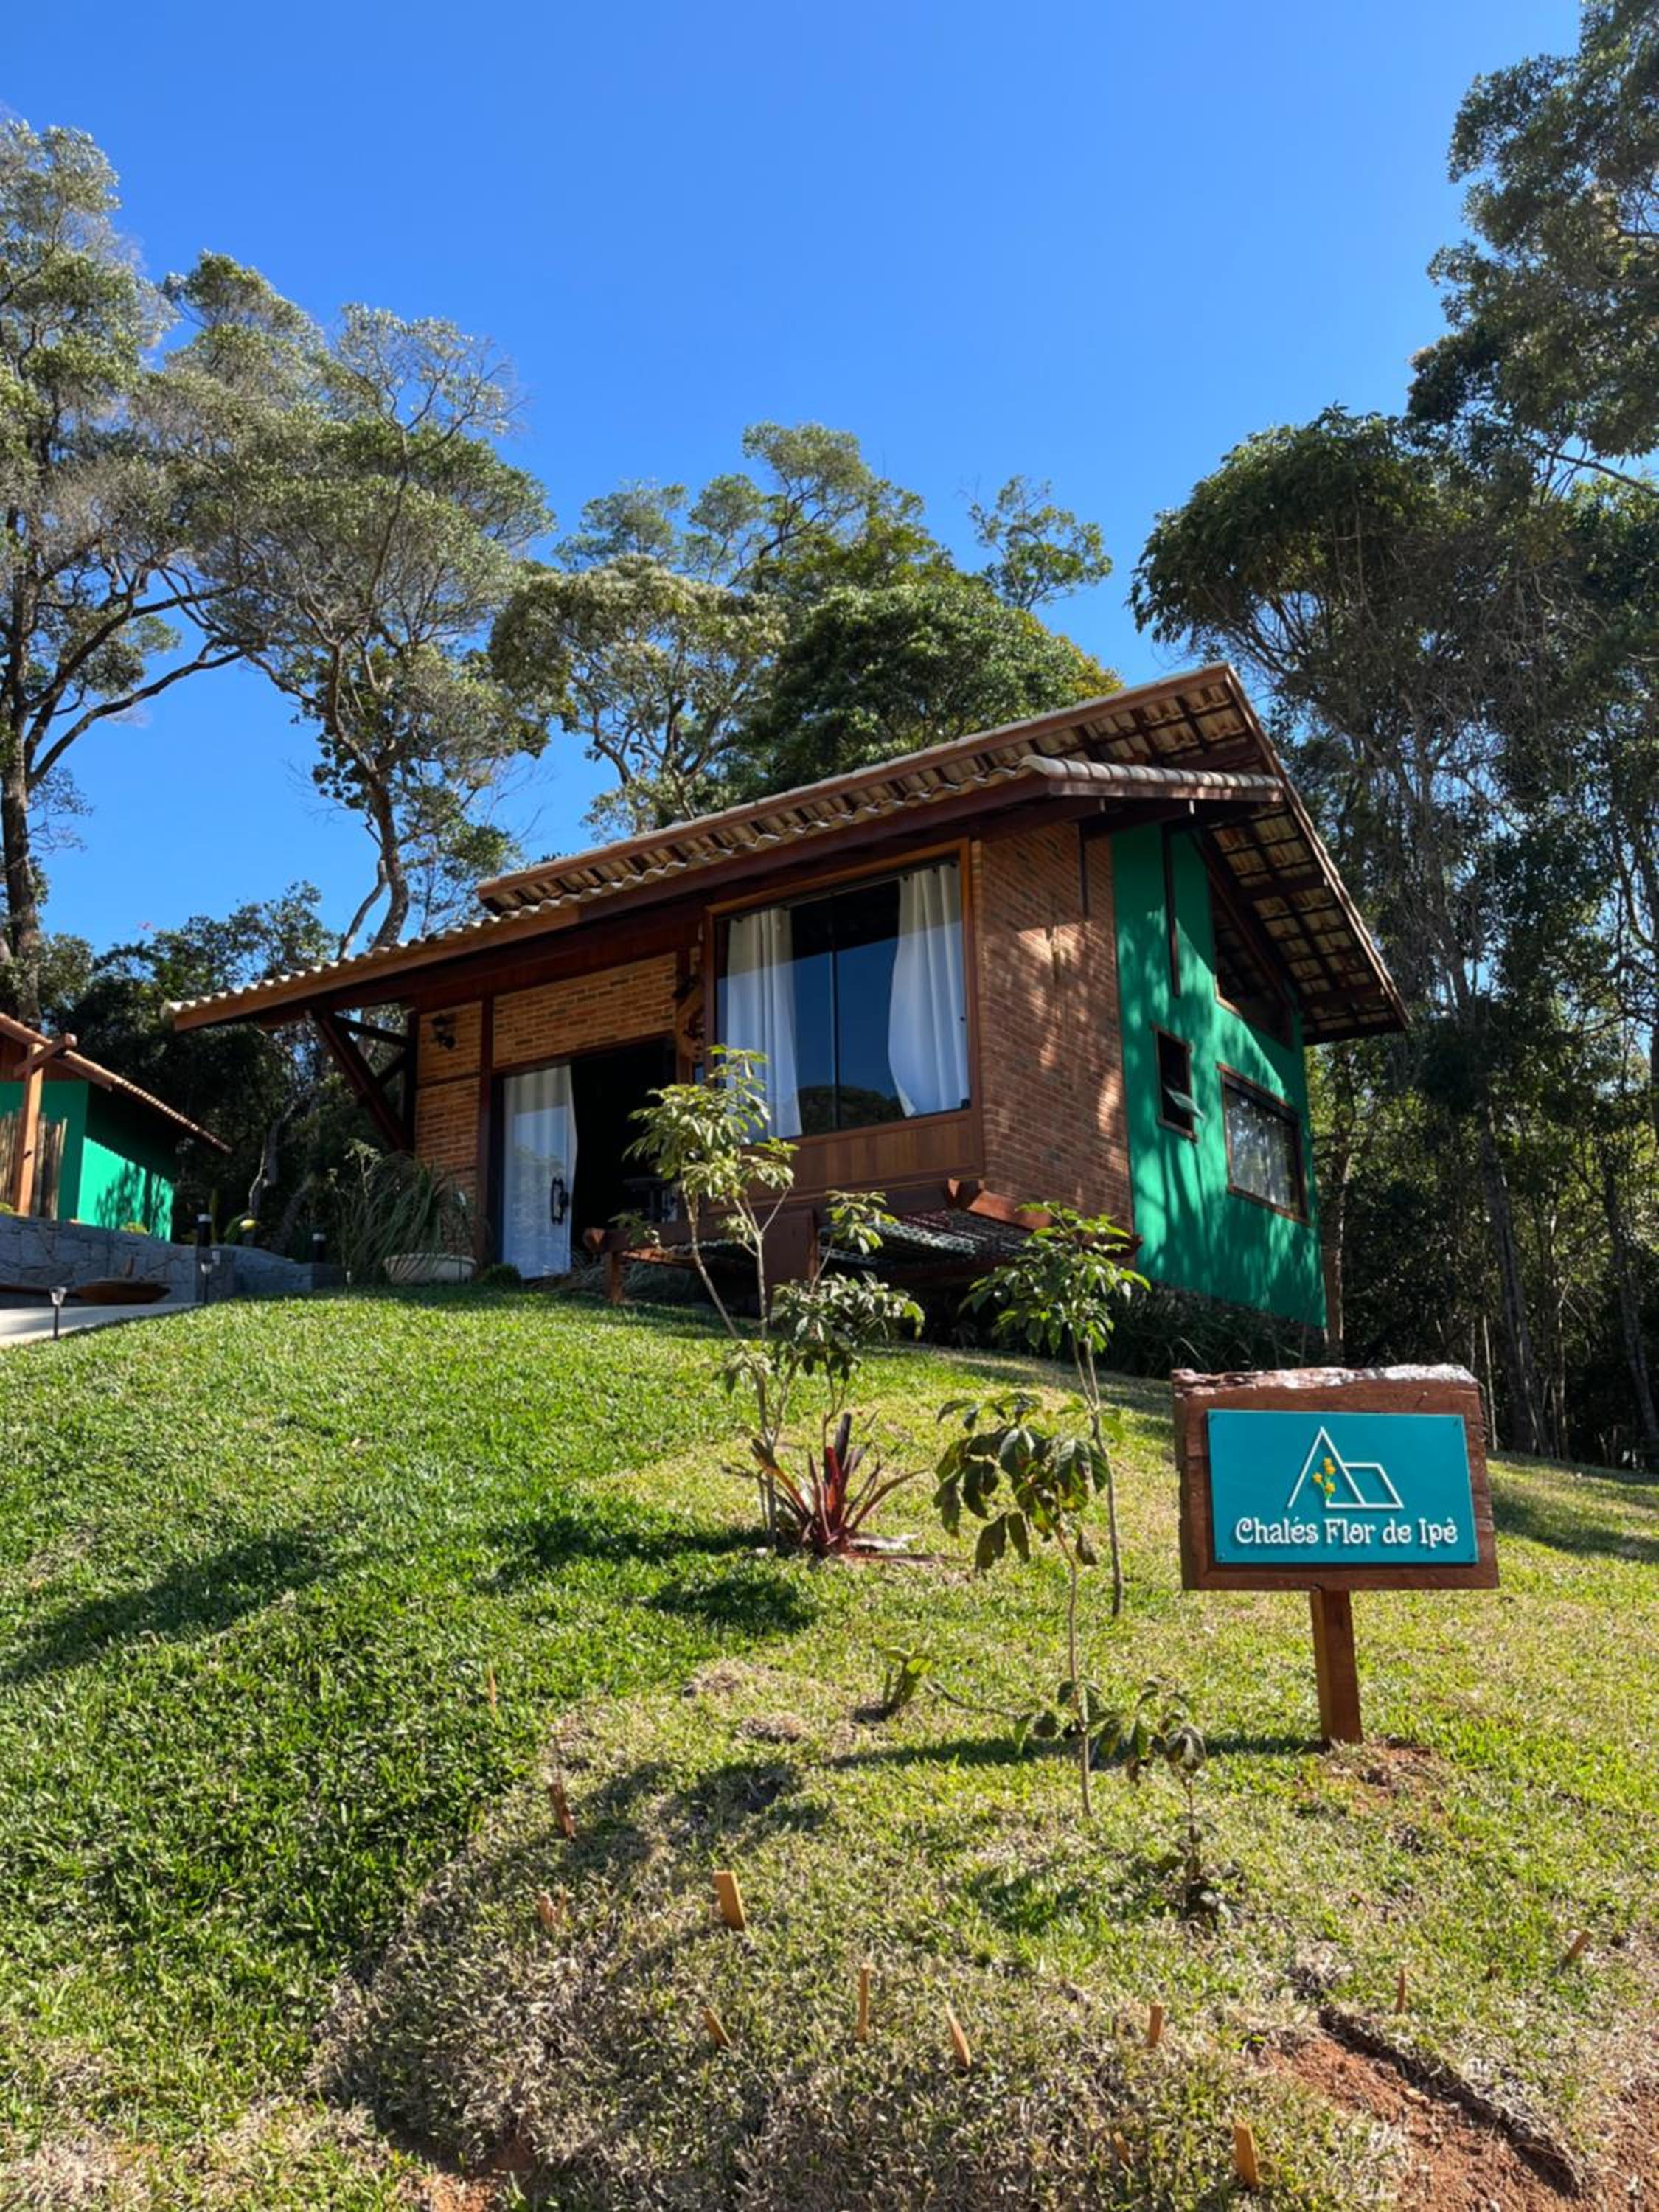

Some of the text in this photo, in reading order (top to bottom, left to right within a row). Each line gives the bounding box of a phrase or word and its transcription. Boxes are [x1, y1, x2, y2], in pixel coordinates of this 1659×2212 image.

[1235, 1517, 1458, 1548] Chalés Flor de Ipê
